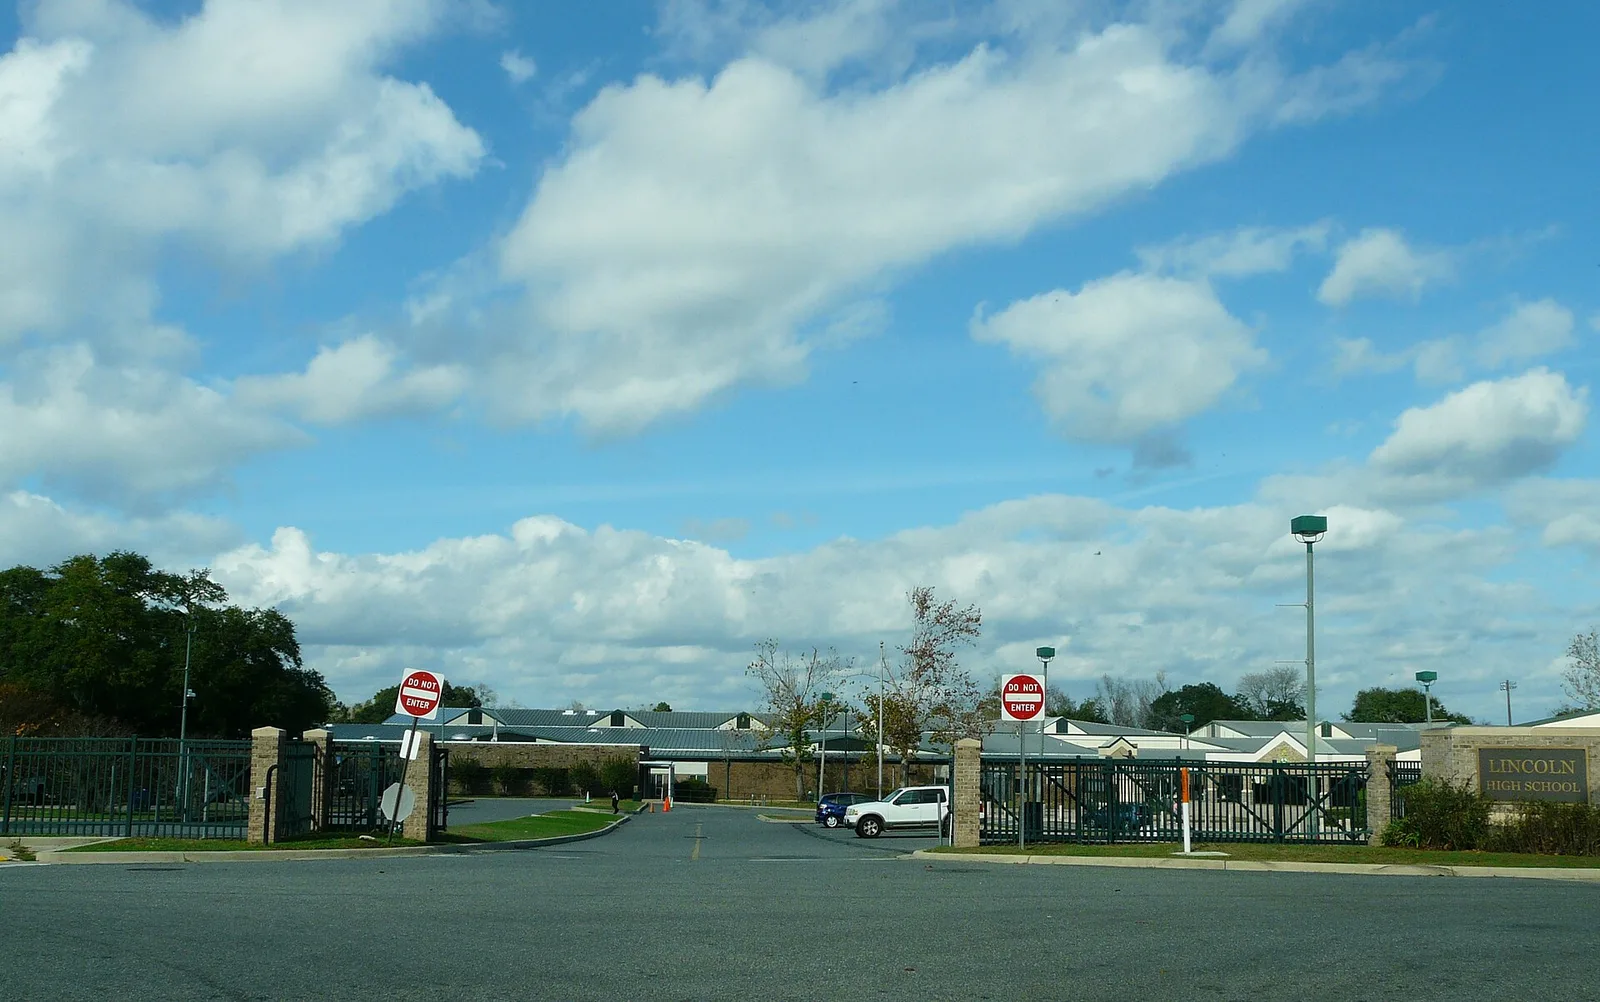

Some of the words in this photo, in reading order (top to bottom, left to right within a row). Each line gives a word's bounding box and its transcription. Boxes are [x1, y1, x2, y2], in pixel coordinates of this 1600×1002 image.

[408, 678, 419, 687] DO
[421, 680, 437, 690] NOT
[1008, 683, 1019, 691] DO
[1023, 683, 1038, 692] NOT
[406, 698, 430, 709] ENTER
[1011, 703, 1035, 712] ENTER
[1488, 759, 1576, 774] LINCOLN
[1486, 780, 1521, 792] HIGH
[1524, 781, 1581, 792] SCHOOL
